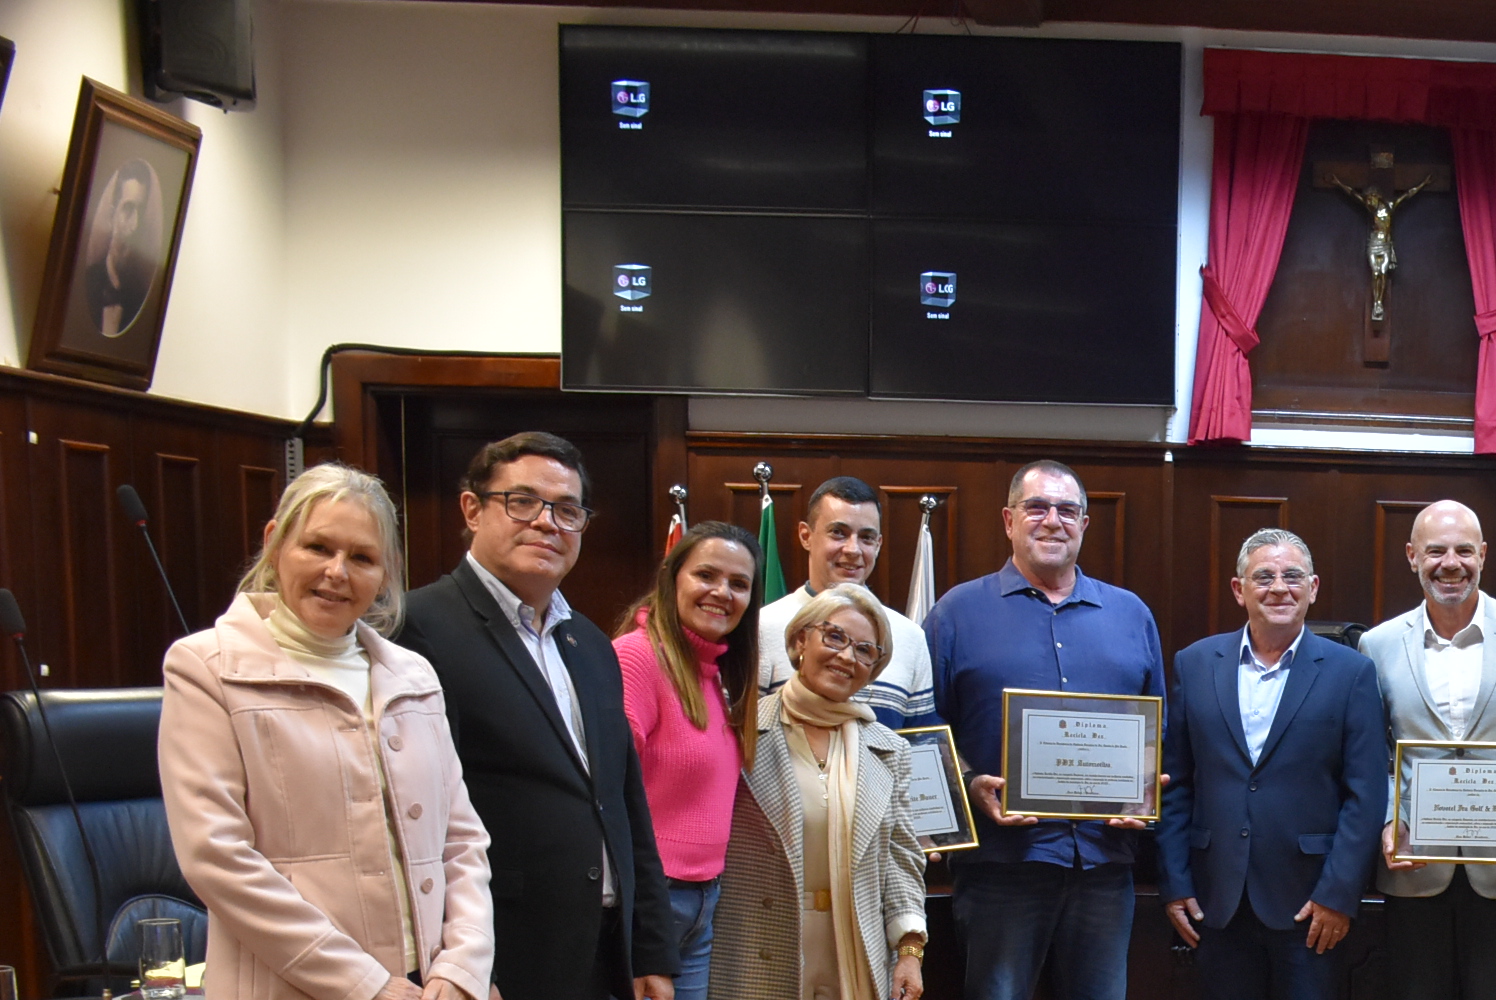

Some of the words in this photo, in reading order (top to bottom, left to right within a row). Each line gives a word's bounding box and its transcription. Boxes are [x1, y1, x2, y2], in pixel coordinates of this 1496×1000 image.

[630, 92, 646, 103] LG
[940, 101, 955, 111] LG
[632, 276, 647, 287] LG
[1075, 721, 1107, 729] Diploma
[1433, 803, 1456, 812] Novotel
